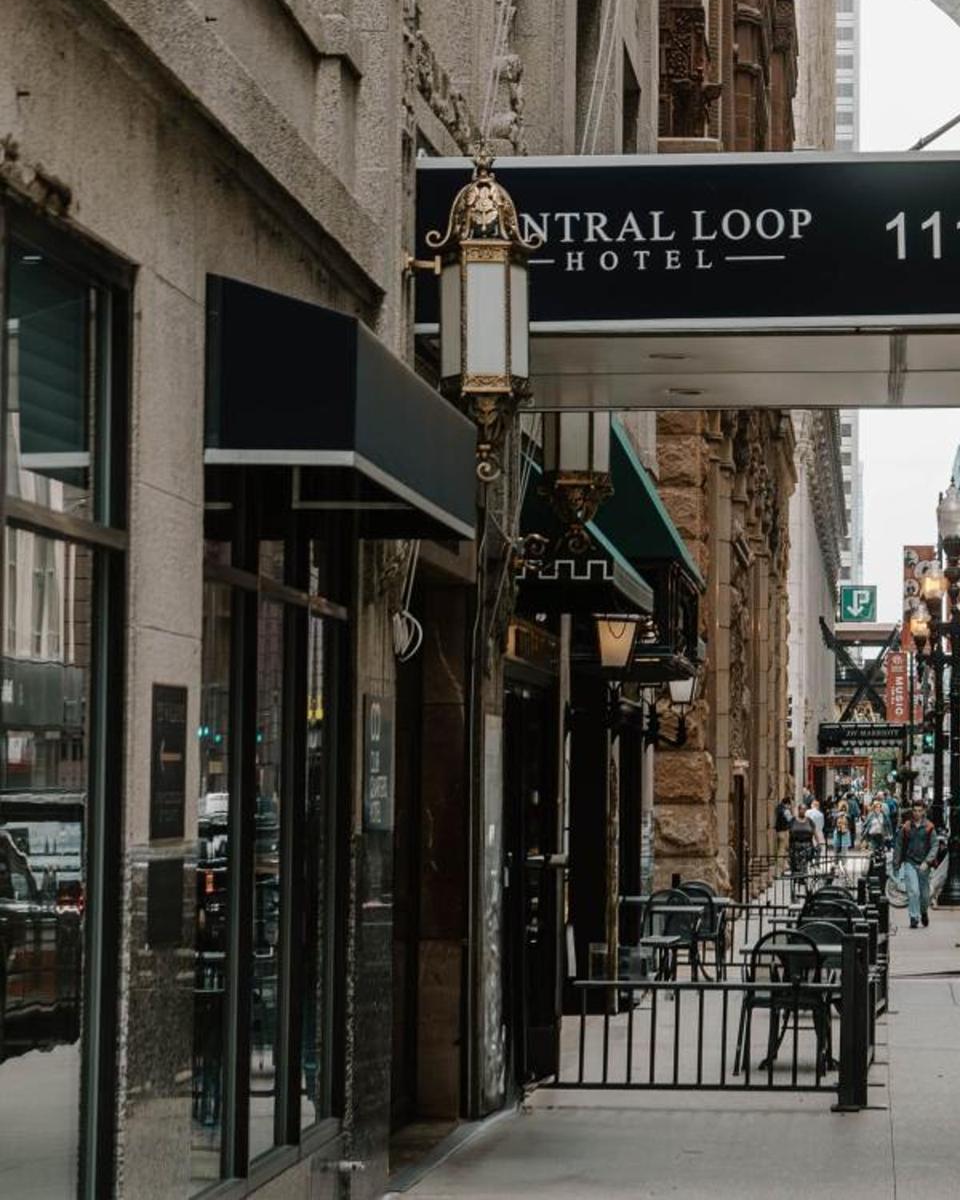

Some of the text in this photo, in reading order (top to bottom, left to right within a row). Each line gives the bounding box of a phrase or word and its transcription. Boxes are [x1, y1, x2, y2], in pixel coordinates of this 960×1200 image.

[520, 208, 812, 243] NTRAL LOOP
[566, 249, 713, 271] HOTEL
[894, 676, 905, 716] MUSIC
